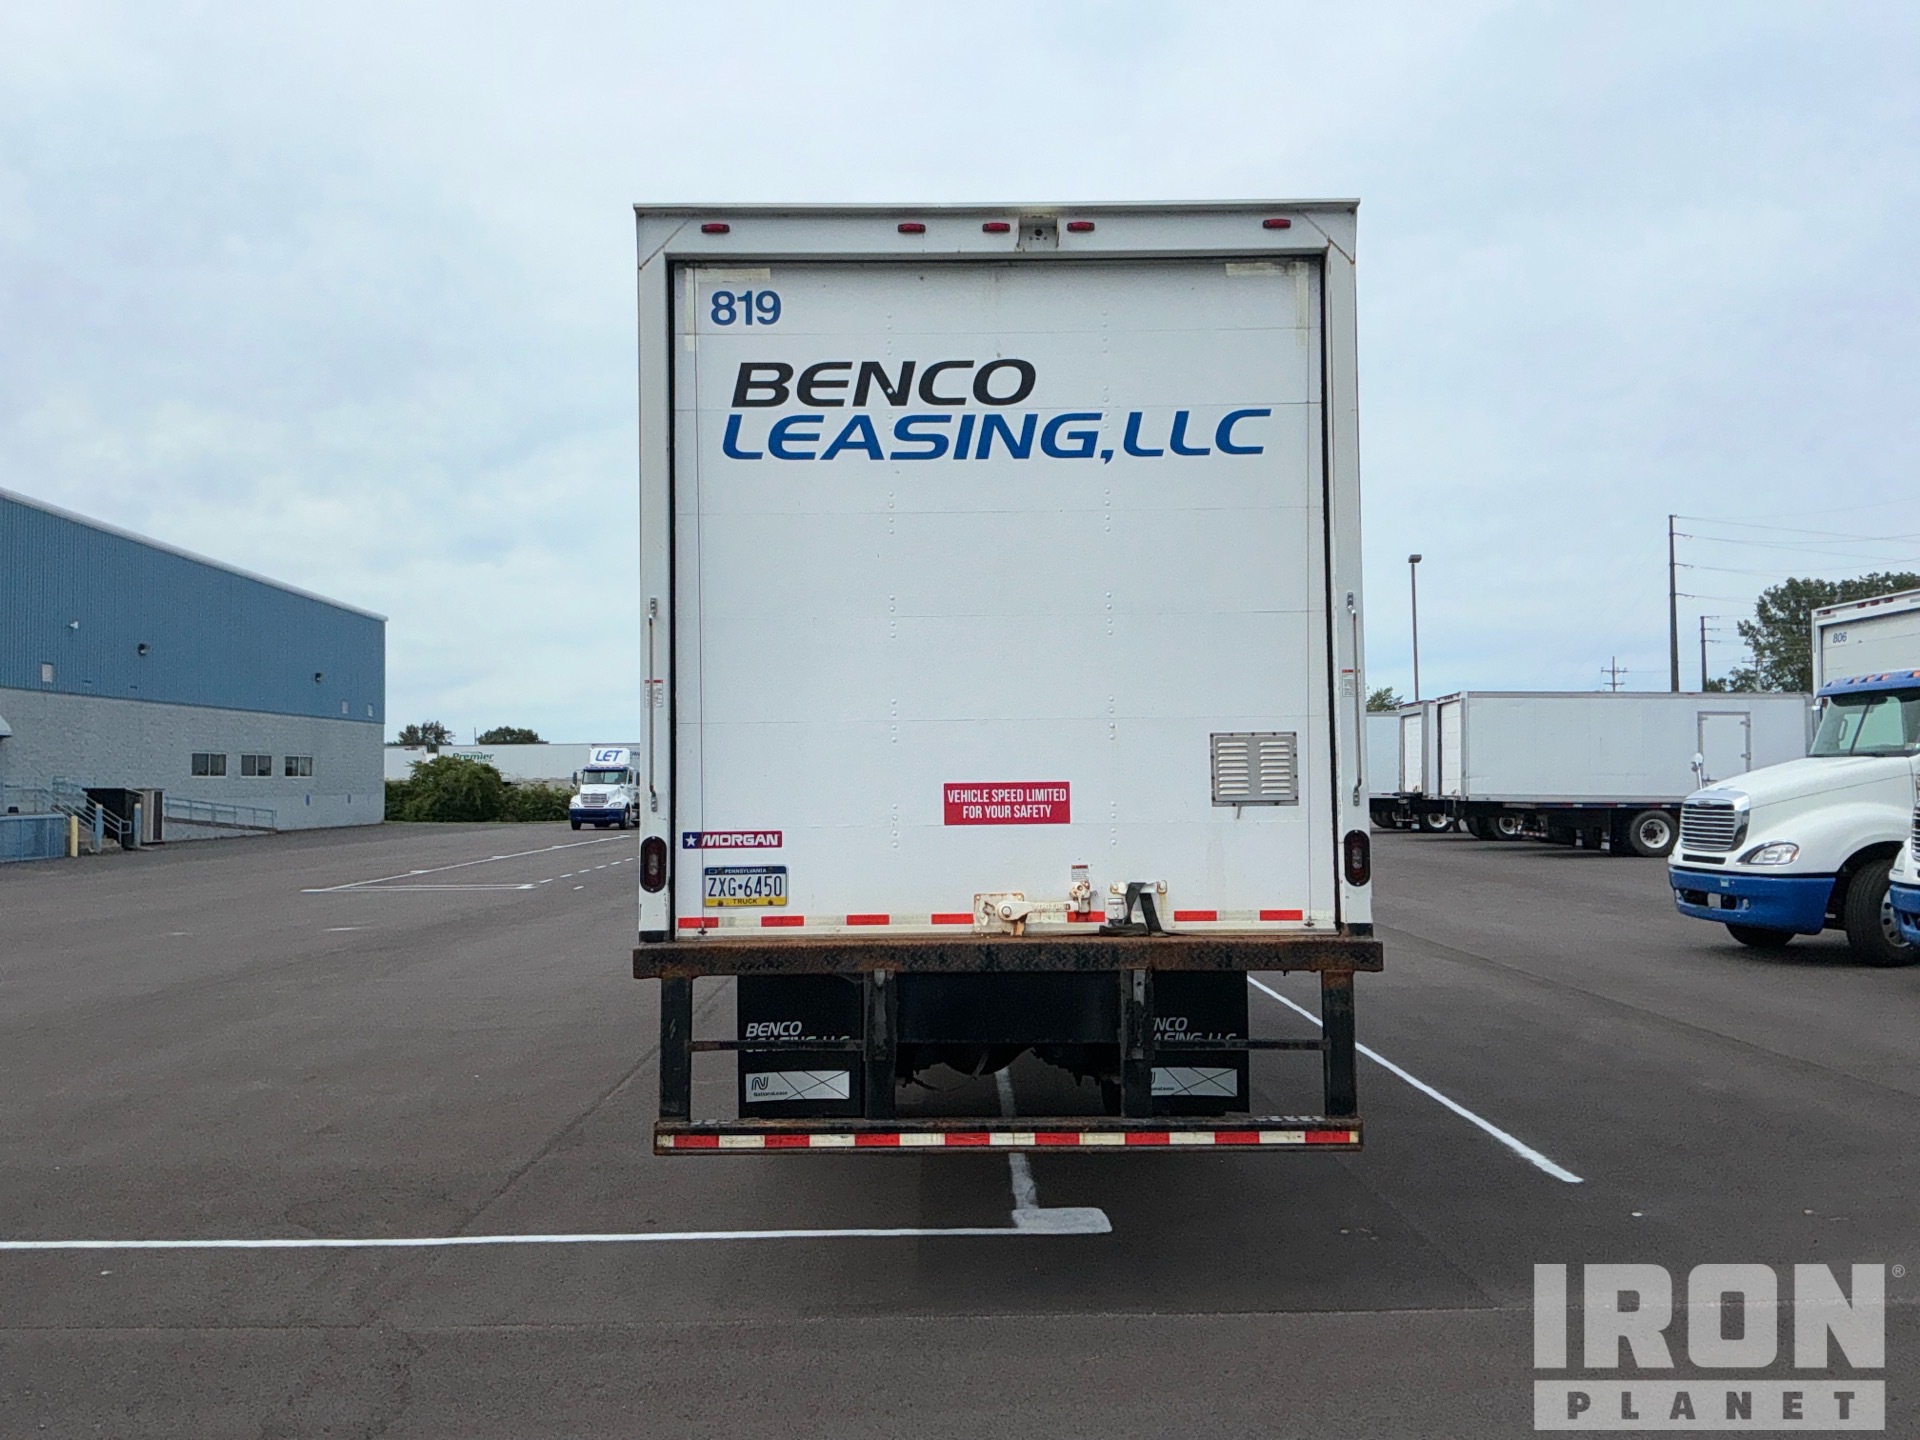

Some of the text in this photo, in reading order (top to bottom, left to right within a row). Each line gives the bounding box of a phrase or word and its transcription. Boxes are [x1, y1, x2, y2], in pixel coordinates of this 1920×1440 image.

[711, 290, 782, 326] 819
[731, 358, 1037, 408] BENCO
[1833, 632, 1847, 643] 806
[453, 752, 495, 761] Premier
[595, 750, 623, 762] LET
[947, 788, 1067, 803] VEHICLE SPEED LIMITED
[963, 804, 1052, 819] FOR YOUR SAFETY
[701, 833, 779, 847] MORGAN
[745, 1021, 803, 1037] BENCO
[1152, 1017, 1188, 1031] NCO
